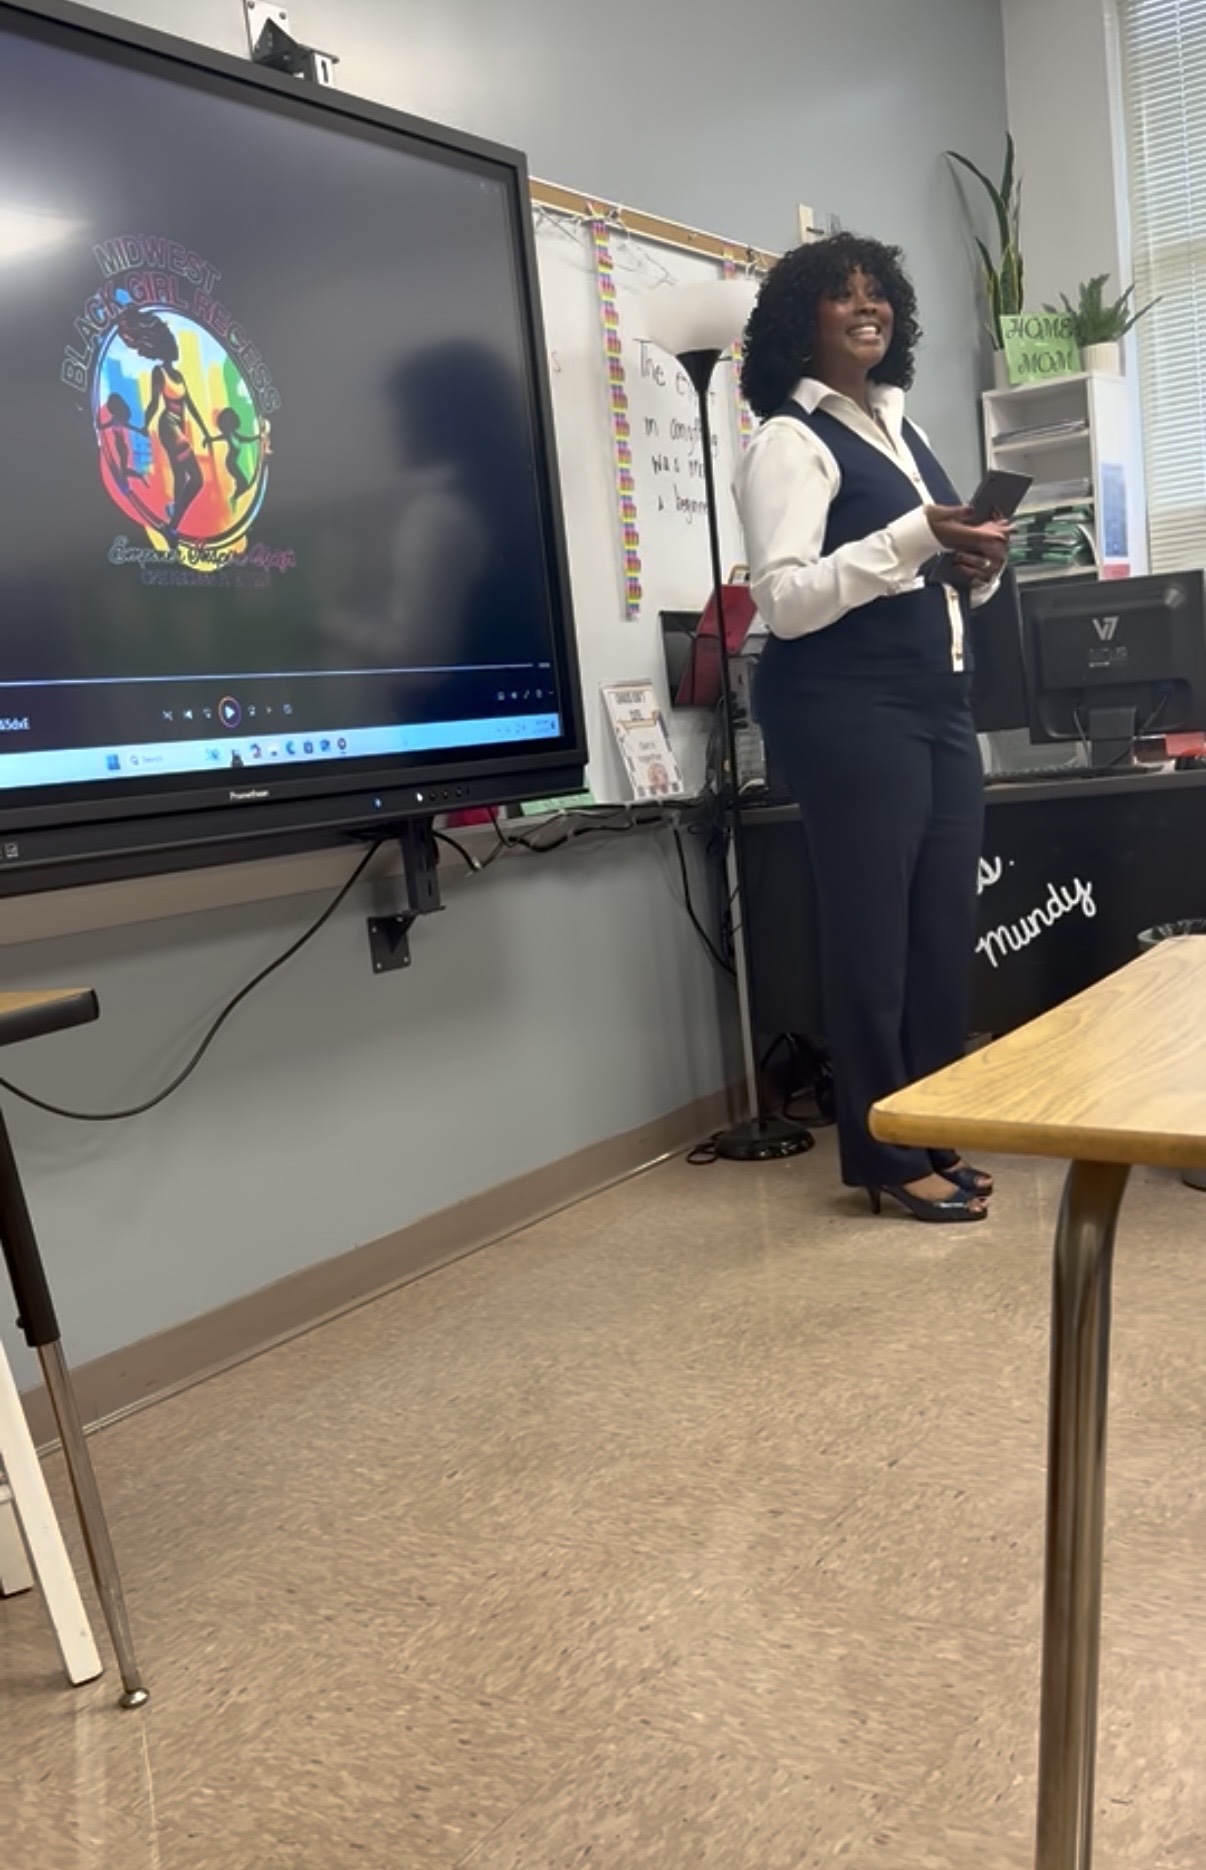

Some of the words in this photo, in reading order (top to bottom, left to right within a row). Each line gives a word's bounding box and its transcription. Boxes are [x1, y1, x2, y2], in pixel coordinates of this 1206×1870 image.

[92, 234, 222, 293] MIDWEST
[60, 280, 128, 392] BLACK
[125, 271, 189, 309] GIRL
[193, 288, 283, 413] RECESS
[632, 338, 666, 387] The
[1018, 350, 1073, 375] MOM
[1091, 615, 1120, 641] V7
